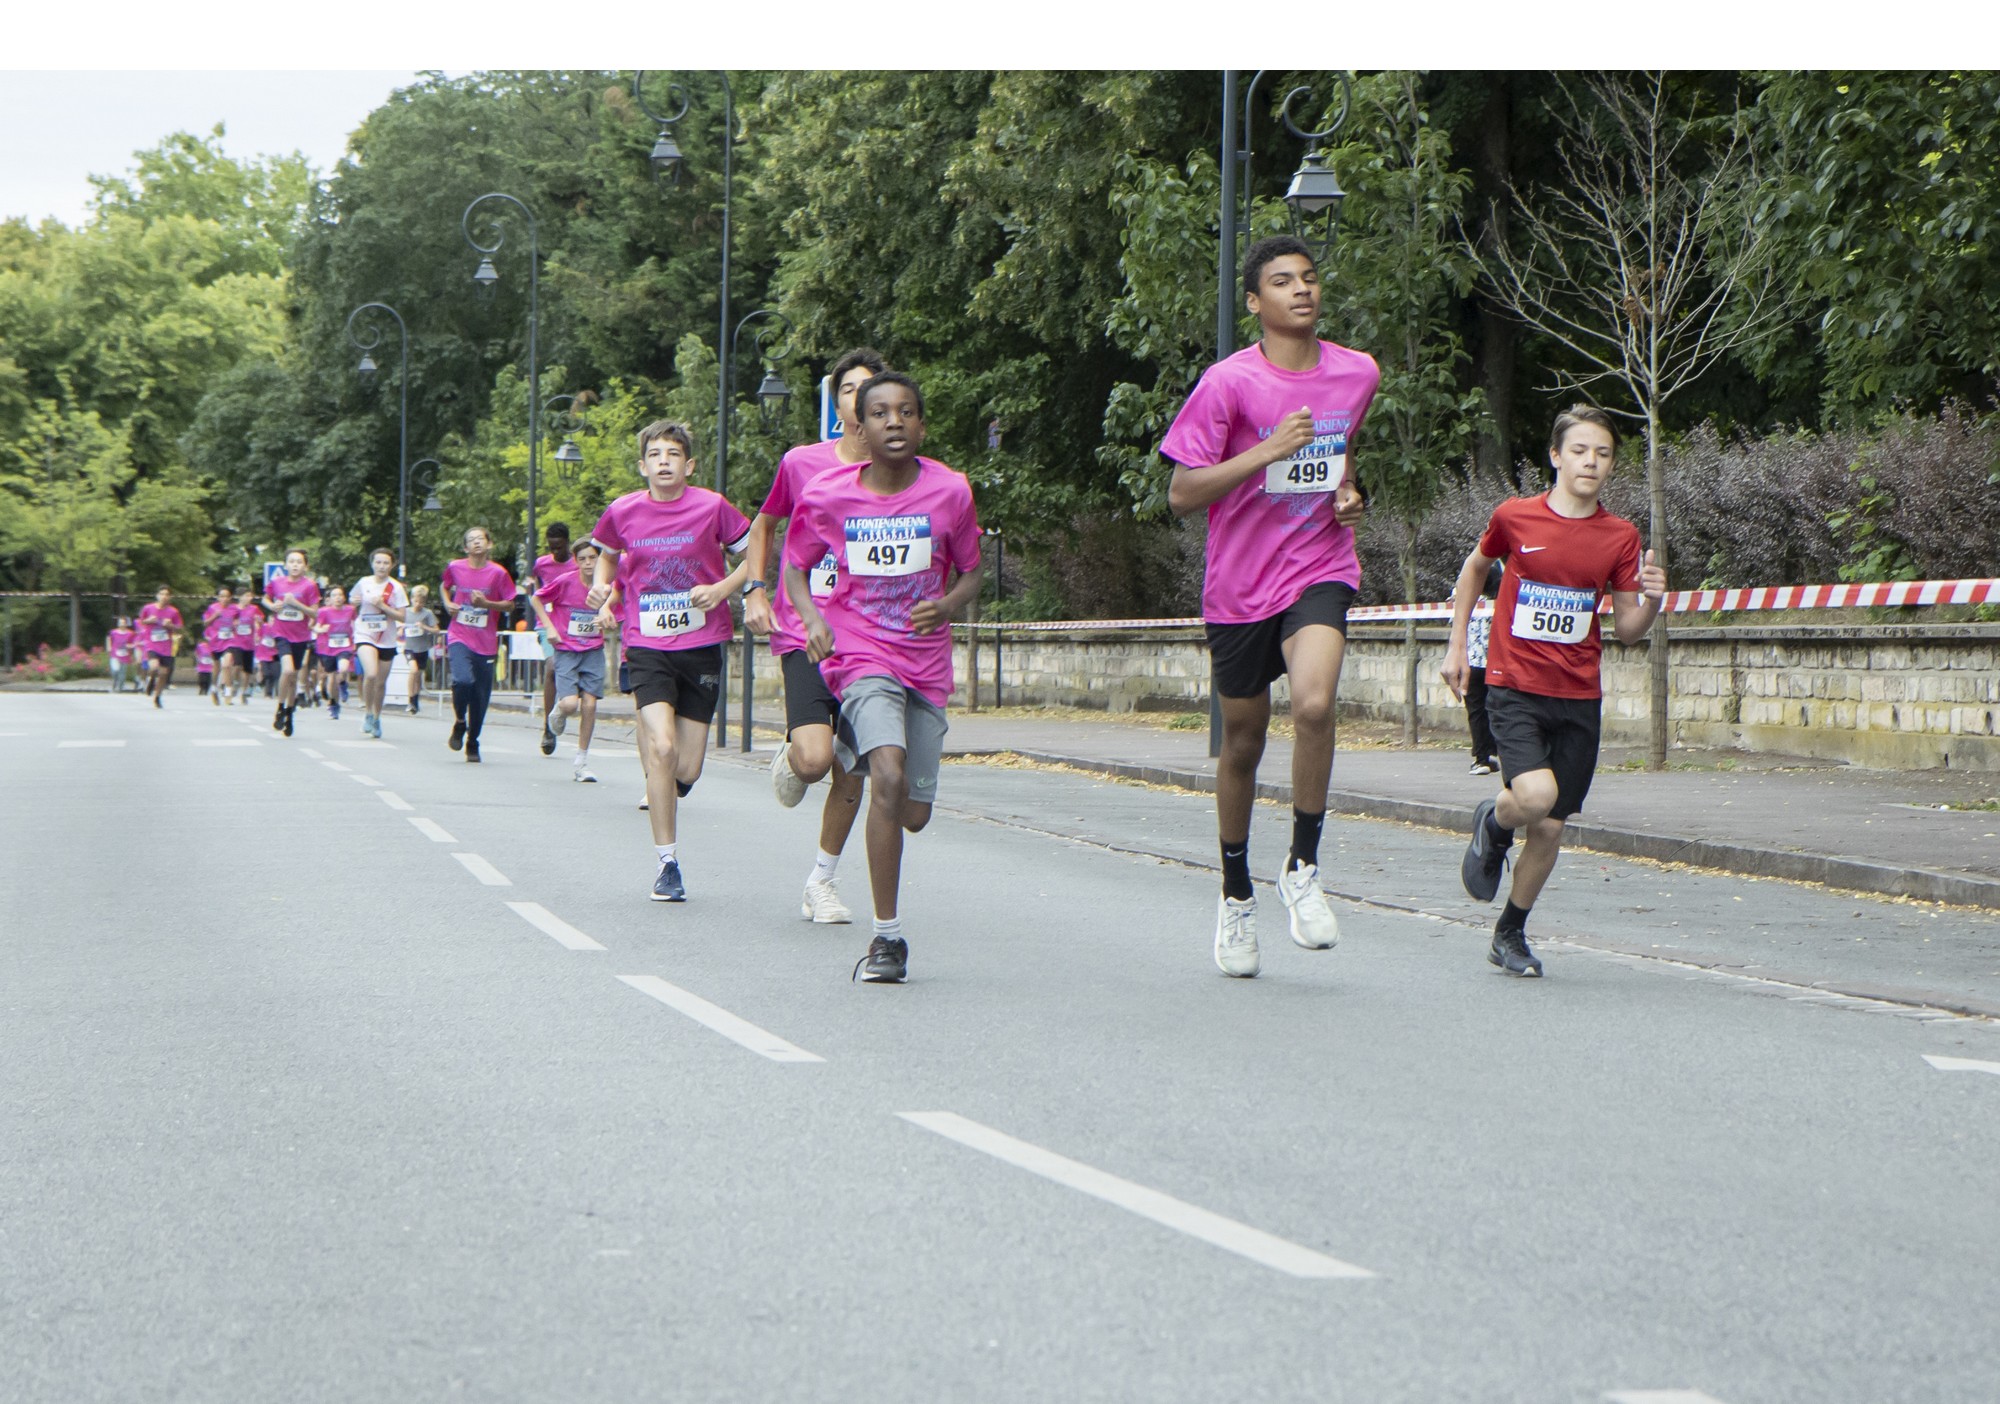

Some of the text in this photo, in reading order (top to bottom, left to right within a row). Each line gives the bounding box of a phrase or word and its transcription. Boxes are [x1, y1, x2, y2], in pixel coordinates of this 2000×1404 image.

[1287, 461, 1329, 484] 499
[845, 515, 929, 529] LA FONTENAISIENNE
[632, 536, 694, 548] LA FONTENAISIENNE
[867, 544, 910, 565] 497
[1520, 583, 1596, 600] LA FONTENAISIENNE
[656, 612, 690, 629] 464
[1532, 611, 1575, 634] 508
